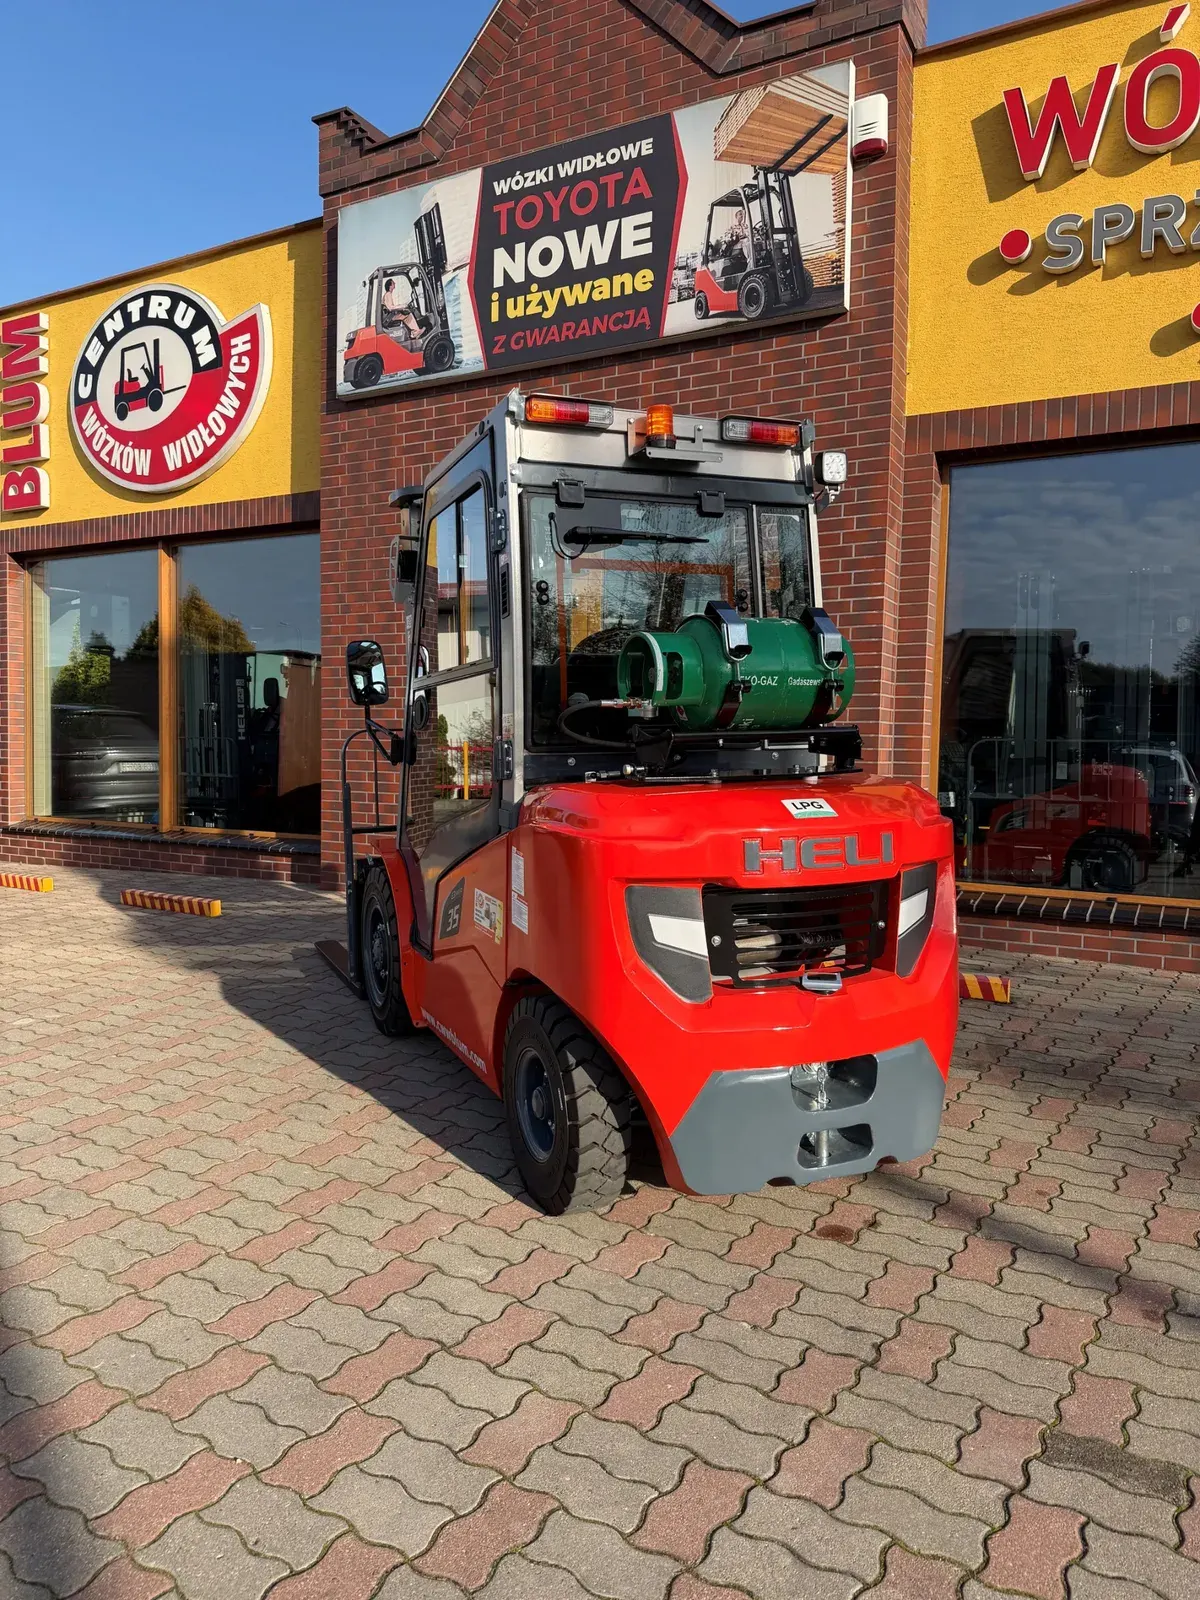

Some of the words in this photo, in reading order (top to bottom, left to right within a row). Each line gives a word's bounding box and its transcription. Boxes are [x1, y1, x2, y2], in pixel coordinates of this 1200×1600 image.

[493, 165, 554, 196] WÓZKI
[557, 137, 654, 179] WIDŁOWE
[493, 166, 653, 235] TOYOTA
[1042, 189, 1200, 275] SPR
[493, 211, 653, 288] NOWE
[491, 292, 500, 323] i
[506, 267, 655, 319] używane
[77, 295, 218, 400] CENTRUM
[492, 335, 507, 355] Z
[510, 306, 651, 350] GWARANCJĄ
[1, 312, 49, 512] BLUM
[81, 406, 152, 477] WÓZKÓW
[162, 332, 252, 472] WIDŁOWYCH
[791, 801, 824, 810] LPG
[743, 832, 894, 873] HELI
[446, 904, 460, 932] 35
